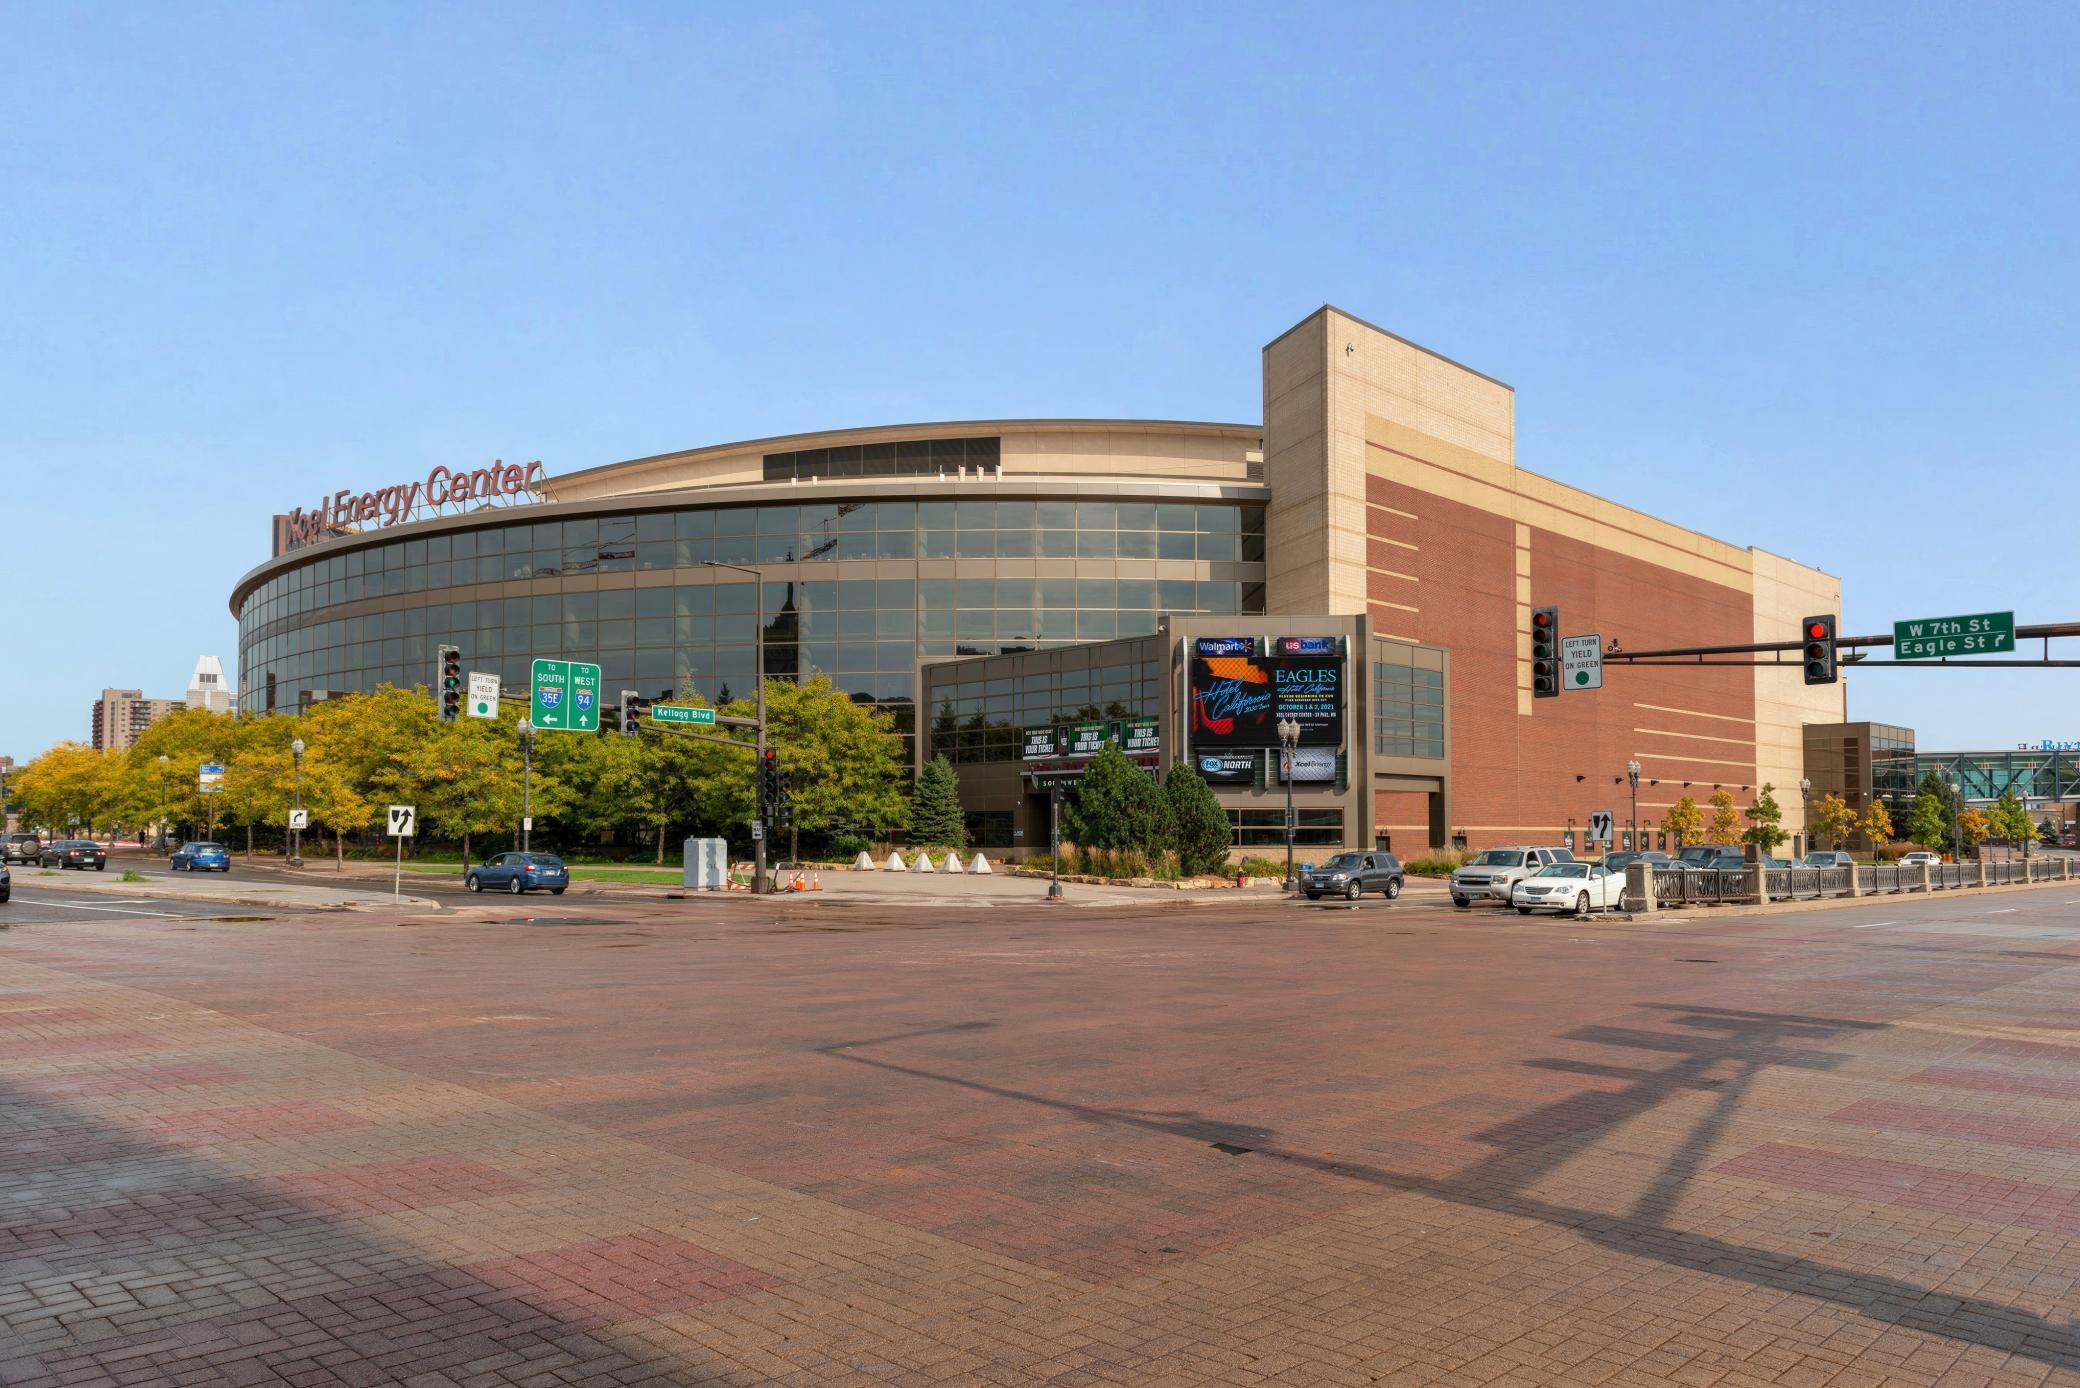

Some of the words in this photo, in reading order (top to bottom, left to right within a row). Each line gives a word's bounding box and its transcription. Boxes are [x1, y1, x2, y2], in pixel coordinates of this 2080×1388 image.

[289, 496, 329, 545] Xcel
[333, 482, 419, 528] Energy
[427, 459, 542, 505] Center
[1909, 624, 1923, 637] W
[1930, 621, 1961, 635] 7th
[1969, 619, 1990, 631] St
[1200, 641, 1239, 651] Walmart
[1901, 639, 1957, 655] Eagle
[1964, 636, 1985, 649] St
[1571, 650, 1592, 658] YIELD
[547, 663, 556, 671] TO
[1565, 662, 1574, 670] ON
[537, 673, 565, 684] SOUTH
[1275, 669, 1337, 683] EAGLES
[574, 677, 595, 686] WEST
[476, 685, 493, 693] YIELD
[1193, 675, 1244, 704] Hotel
[542, 693, 558, 704] 35E
[577, 695, 589, 706] 94
[1212, 690, 1272, 720] California
[658, 709, 688, 719] Kellogg
[692, 711, 710, 719] Blvd
[1081, 733, 1092, 741] THIS
[1093, 732, 1099, 740] IS
[1134, 729, 1146, 737] THIS
[1147, 728, 1153, 736] IS
[1031, 736, 1042, 744] THIS
[1042, 736, 1048, 744] IS
[1128, 738, 1141, 748] YOUR
[1025, 745, 1037, 754] YOUR
[1038, 744, 1054, 753] TICKET
[1075, 742, 1087, 751] YOUR
[1205, 759, 1219, 767] FOX
[1223, 760, 1252, 769] NORTH
